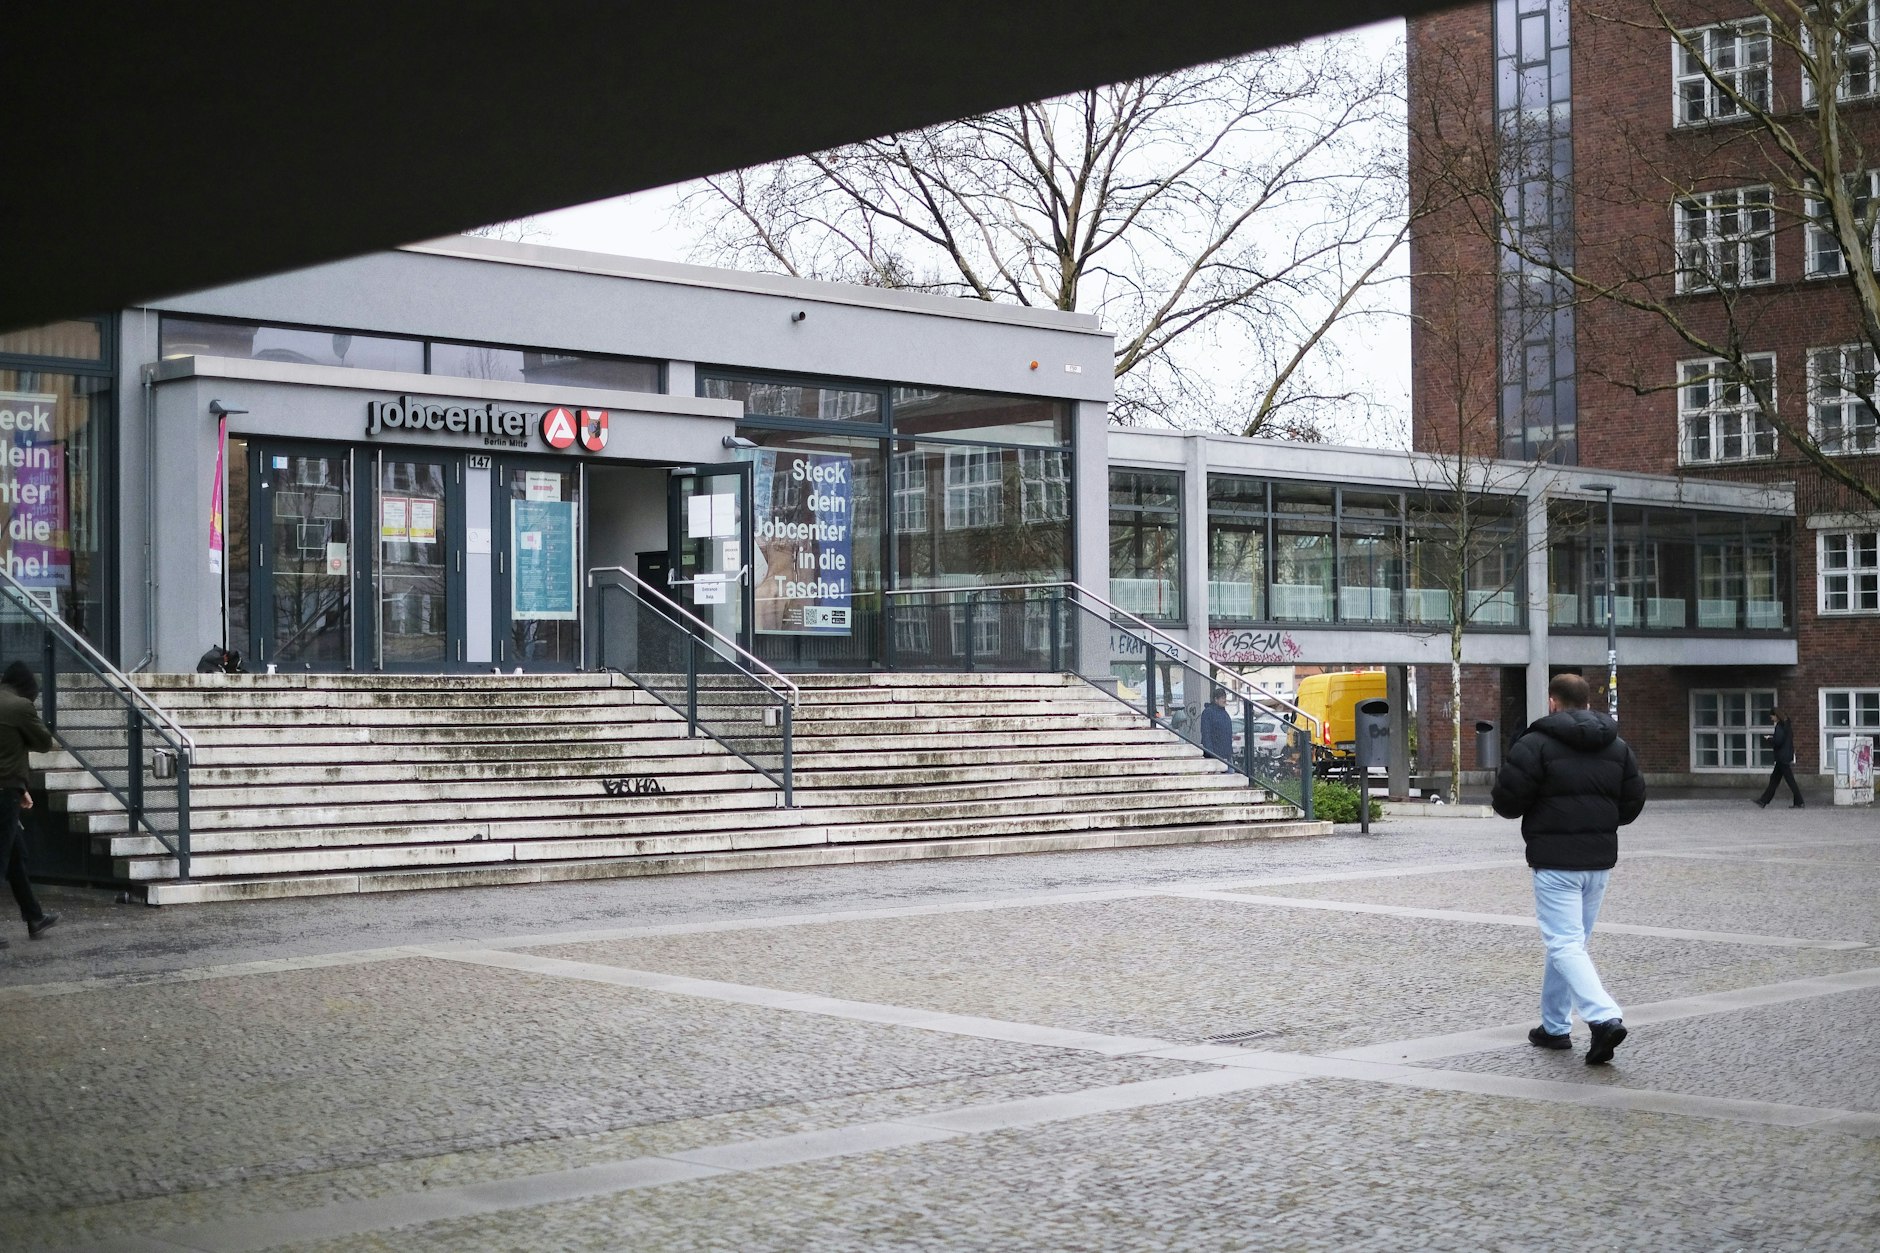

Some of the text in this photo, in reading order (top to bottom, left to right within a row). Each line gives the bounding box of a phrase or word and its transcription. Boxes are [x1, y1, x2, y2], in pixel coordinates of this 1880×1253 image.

[367, 396, 538, 436] jobcenter
[484, 437, 528, 448] Berlin Mitte
[471, 456, 490, 468] 147
[792, 458, 846, 483] Steck
[807, 490, 846, 512] dein
[9, 513, 50, 541] die
[754, 515, 846, 541] Jobcenter
[799, 547, 846, 571] in die
[774, 575, 845, 600] Tasche!
